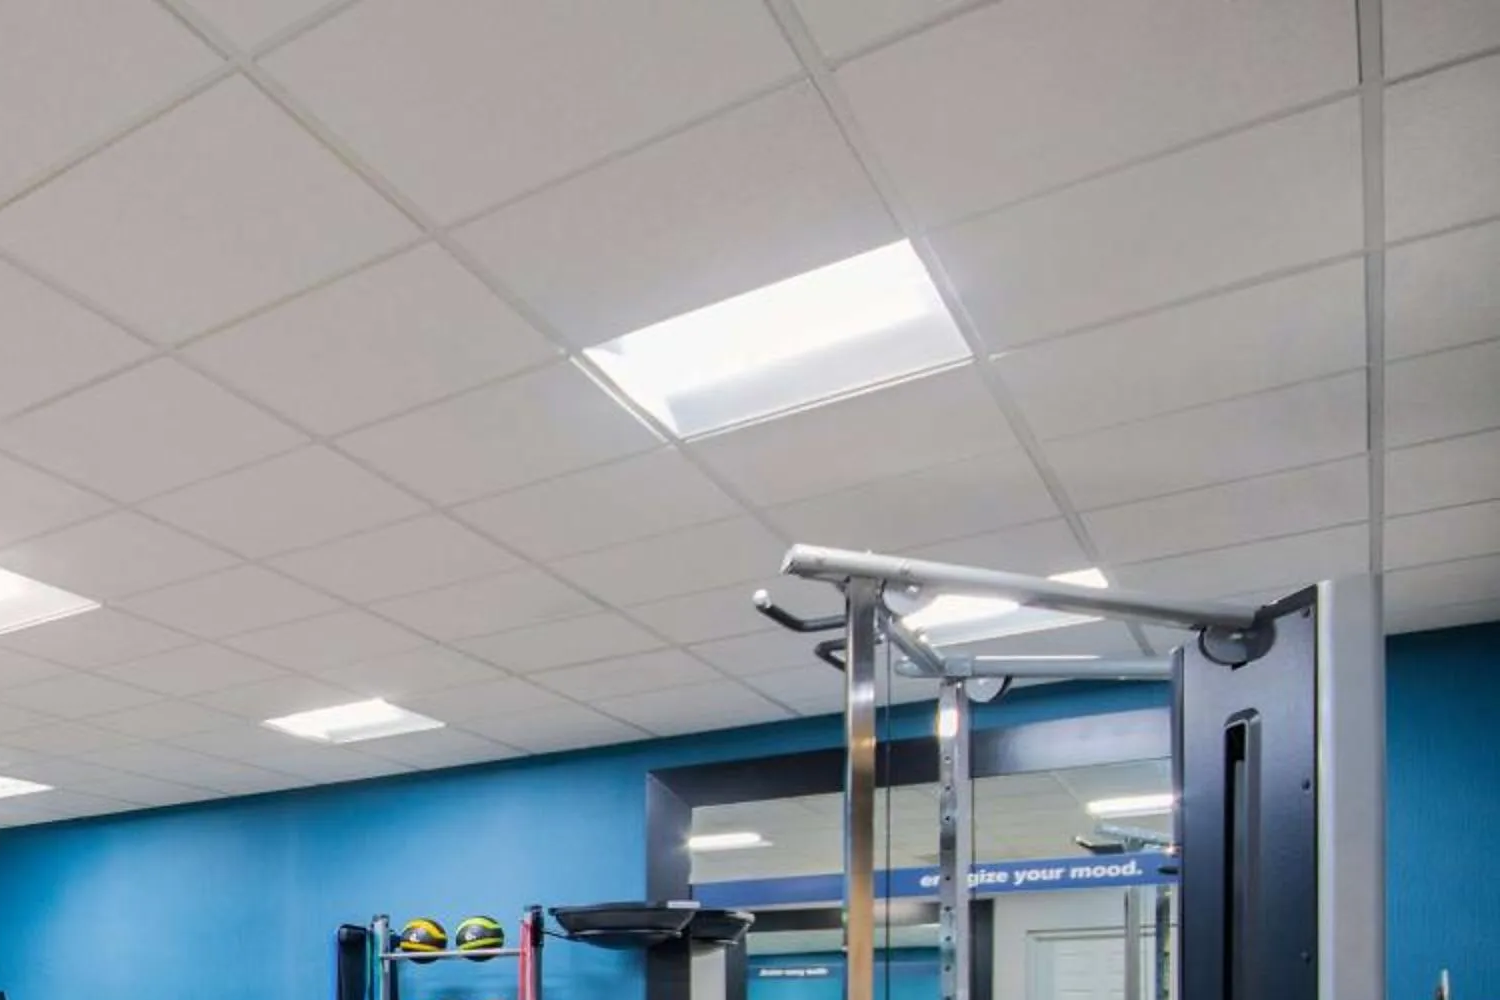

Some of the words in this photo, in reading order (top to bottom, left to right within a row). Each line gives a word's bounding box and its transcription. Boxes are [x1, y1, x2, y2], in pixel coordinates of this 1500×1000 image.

[919, 869, 1009, 888] engize
[1013, 865, 1065, 885] your
[1070, 859, 1143, 879] mood.
